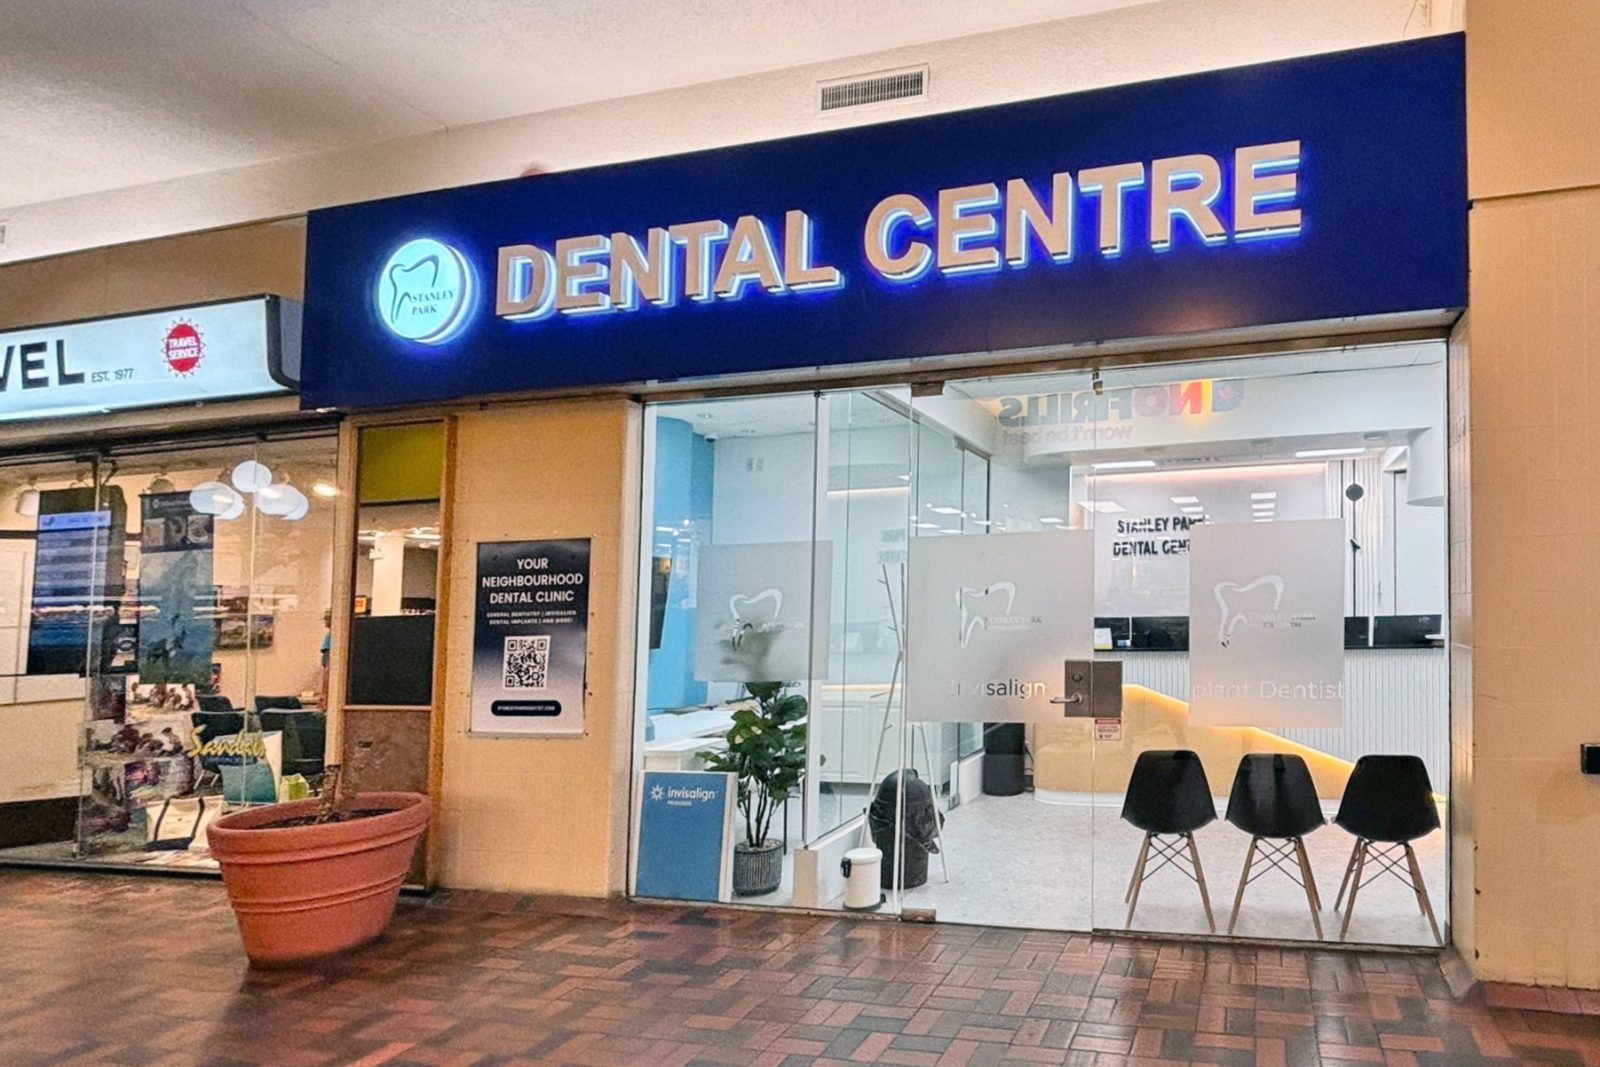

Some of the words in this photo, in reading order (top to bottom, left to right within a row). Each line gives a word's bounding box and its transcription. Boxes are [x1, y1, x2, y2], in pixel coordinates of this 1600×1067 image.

[496, 210, 842, 320] DENTAL
[864, 140, 1301, 280] CENTRE
[412, 290, 454, 303] STANLEY
[412, 305, 437, 315] PARK
[168, 336, 199, 349] TRAVEL
[168, 347, 200, 360] SERVICE
[114, 367, 134, 380] 1977
[1117, 517, 1170, 534] STANLEY
[1172, 515, 1205, 531] PA
[1113, 540, 1158, 556] DENTAL
[517, 557, 549, 570] YOUR
[482, 572, 584, 588] NEIGHBOURHOOD
[489, 591, 533, 604] DENTAL
[535, 590, 575, 603] CLINIC
[667, 786, 716, 802] invisalign
